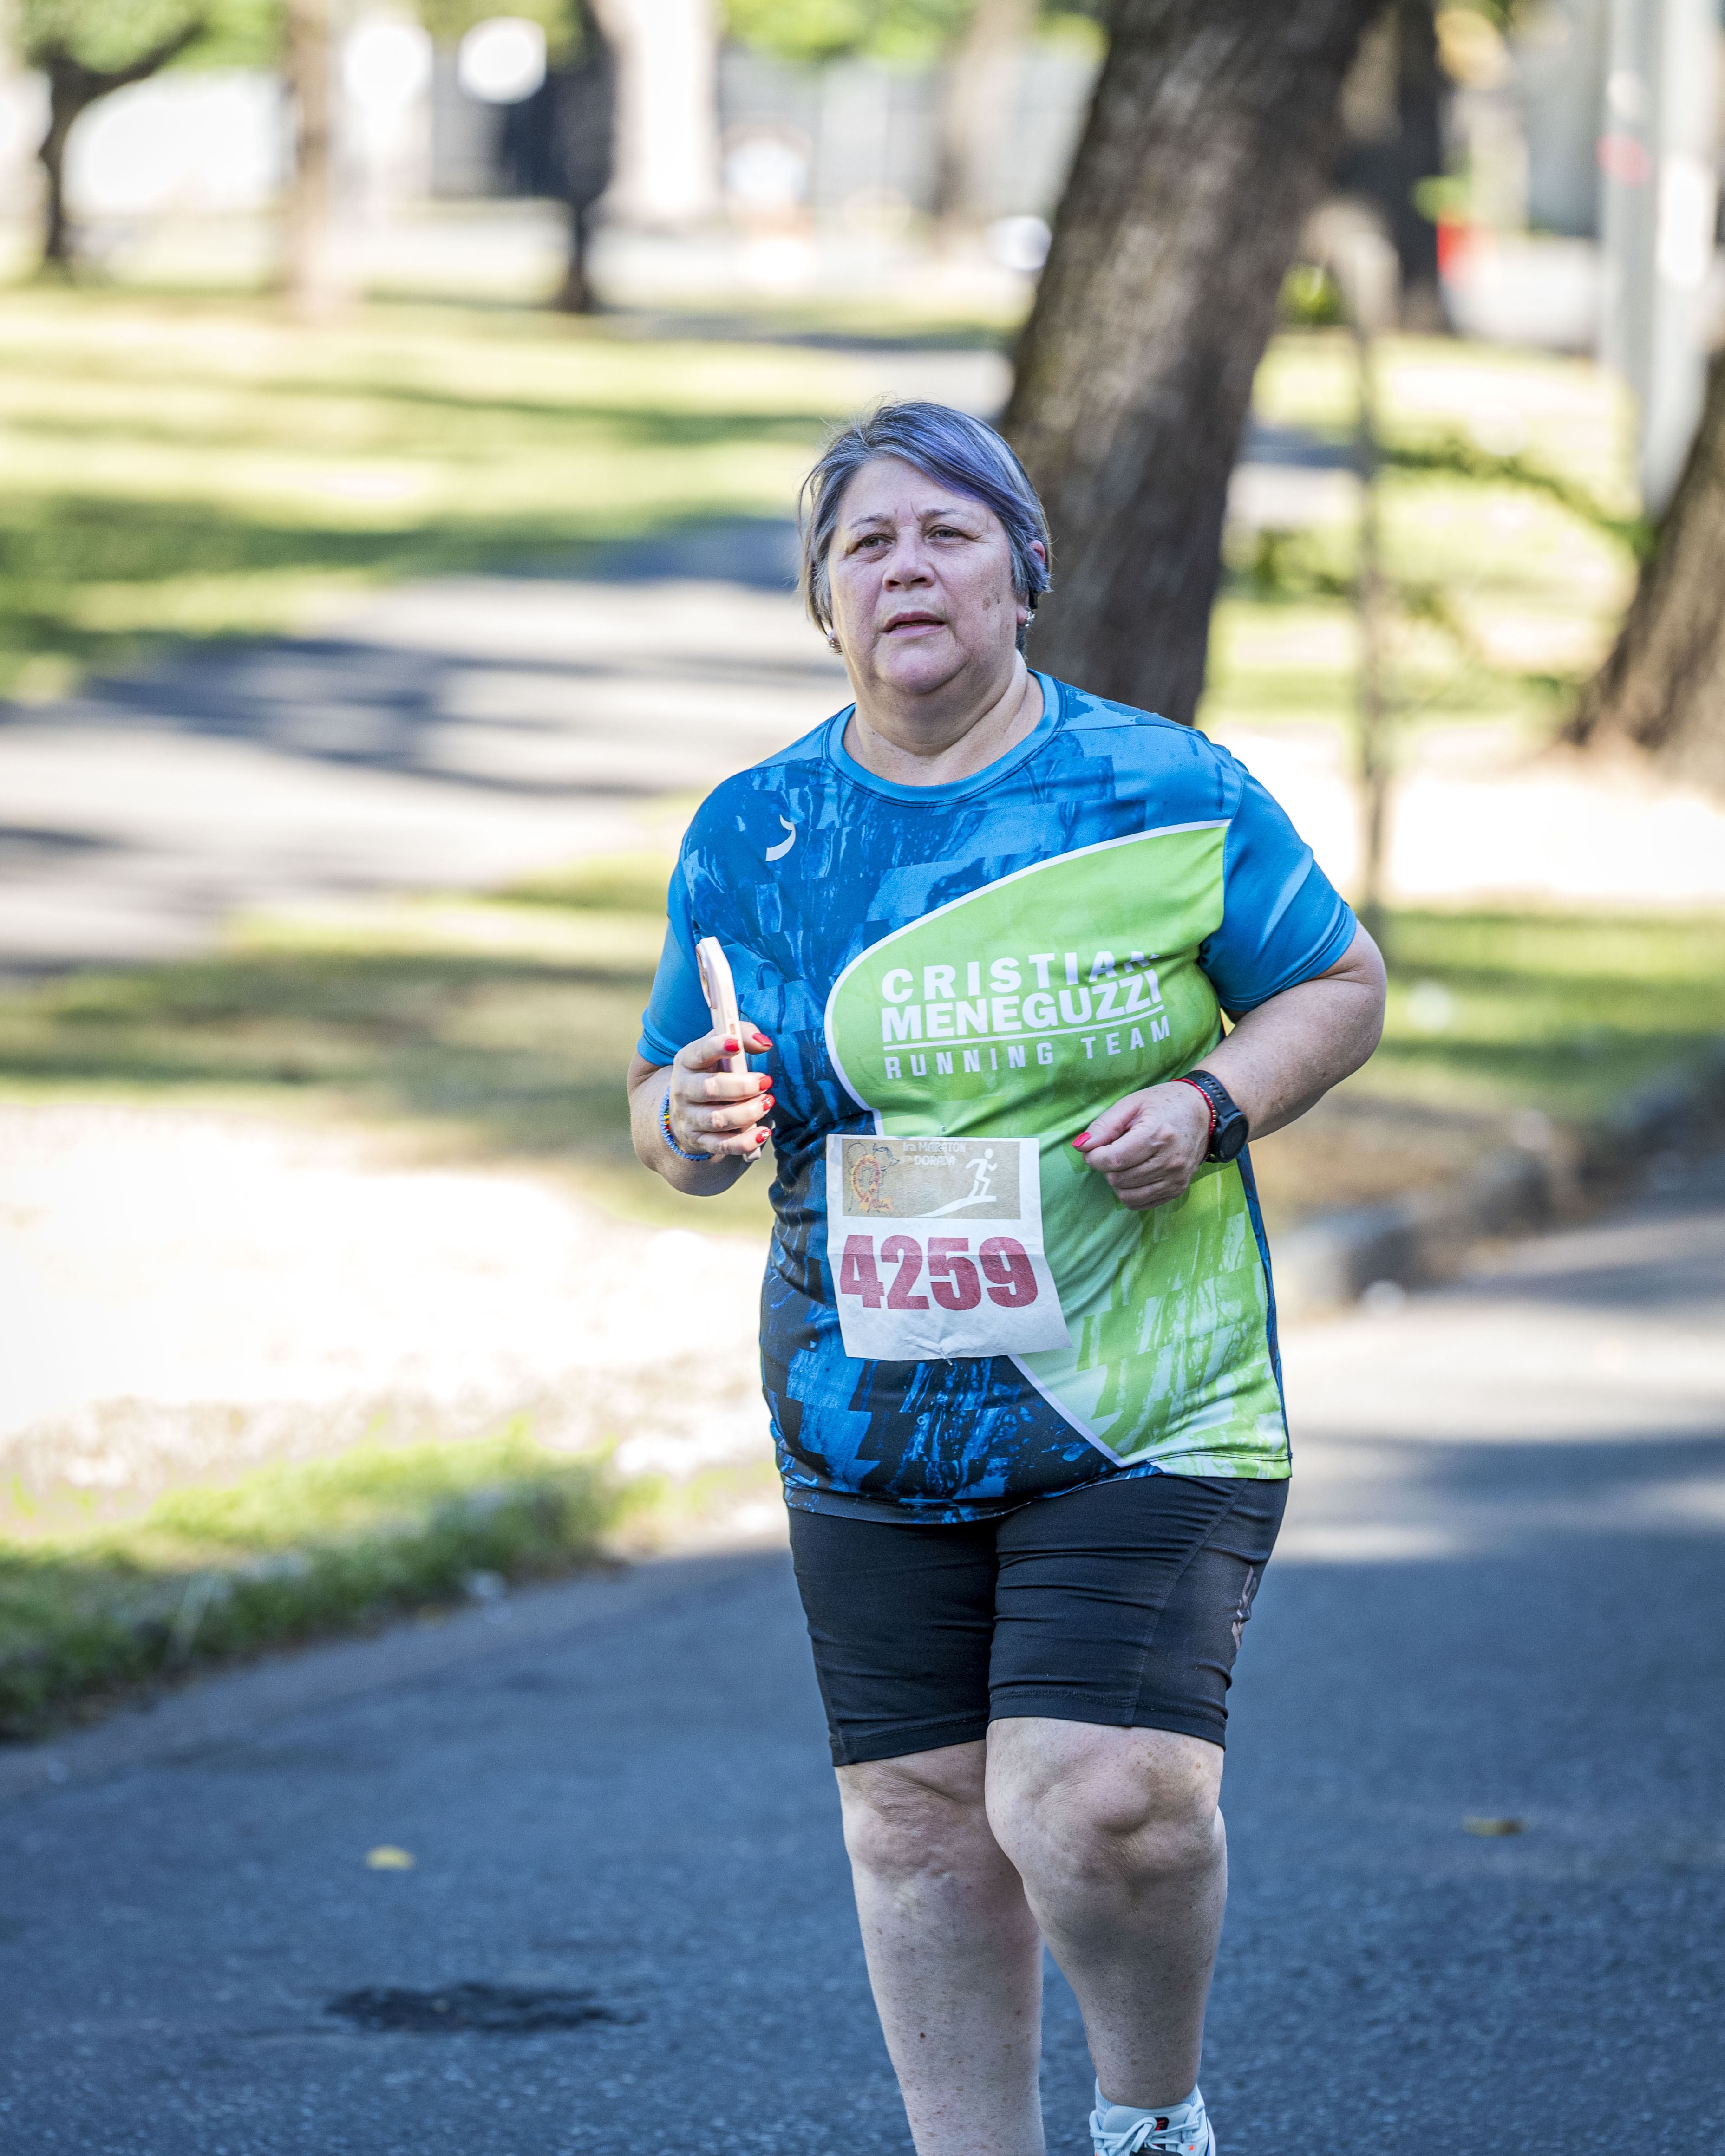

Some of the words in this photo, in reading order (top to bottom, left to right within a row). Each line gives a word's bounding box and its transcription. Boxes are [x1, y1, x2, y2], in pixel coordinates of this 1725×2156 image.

[881, 969, 1163, 1042] MENEGUZZI
[884, 1042, 1053, 1080] RUNNING
[1080, 1015, 1170, 1059] TEAM
[914, 1155, 957, 1166] DORADA
[840, 1234, 1038, 1311] 4259
